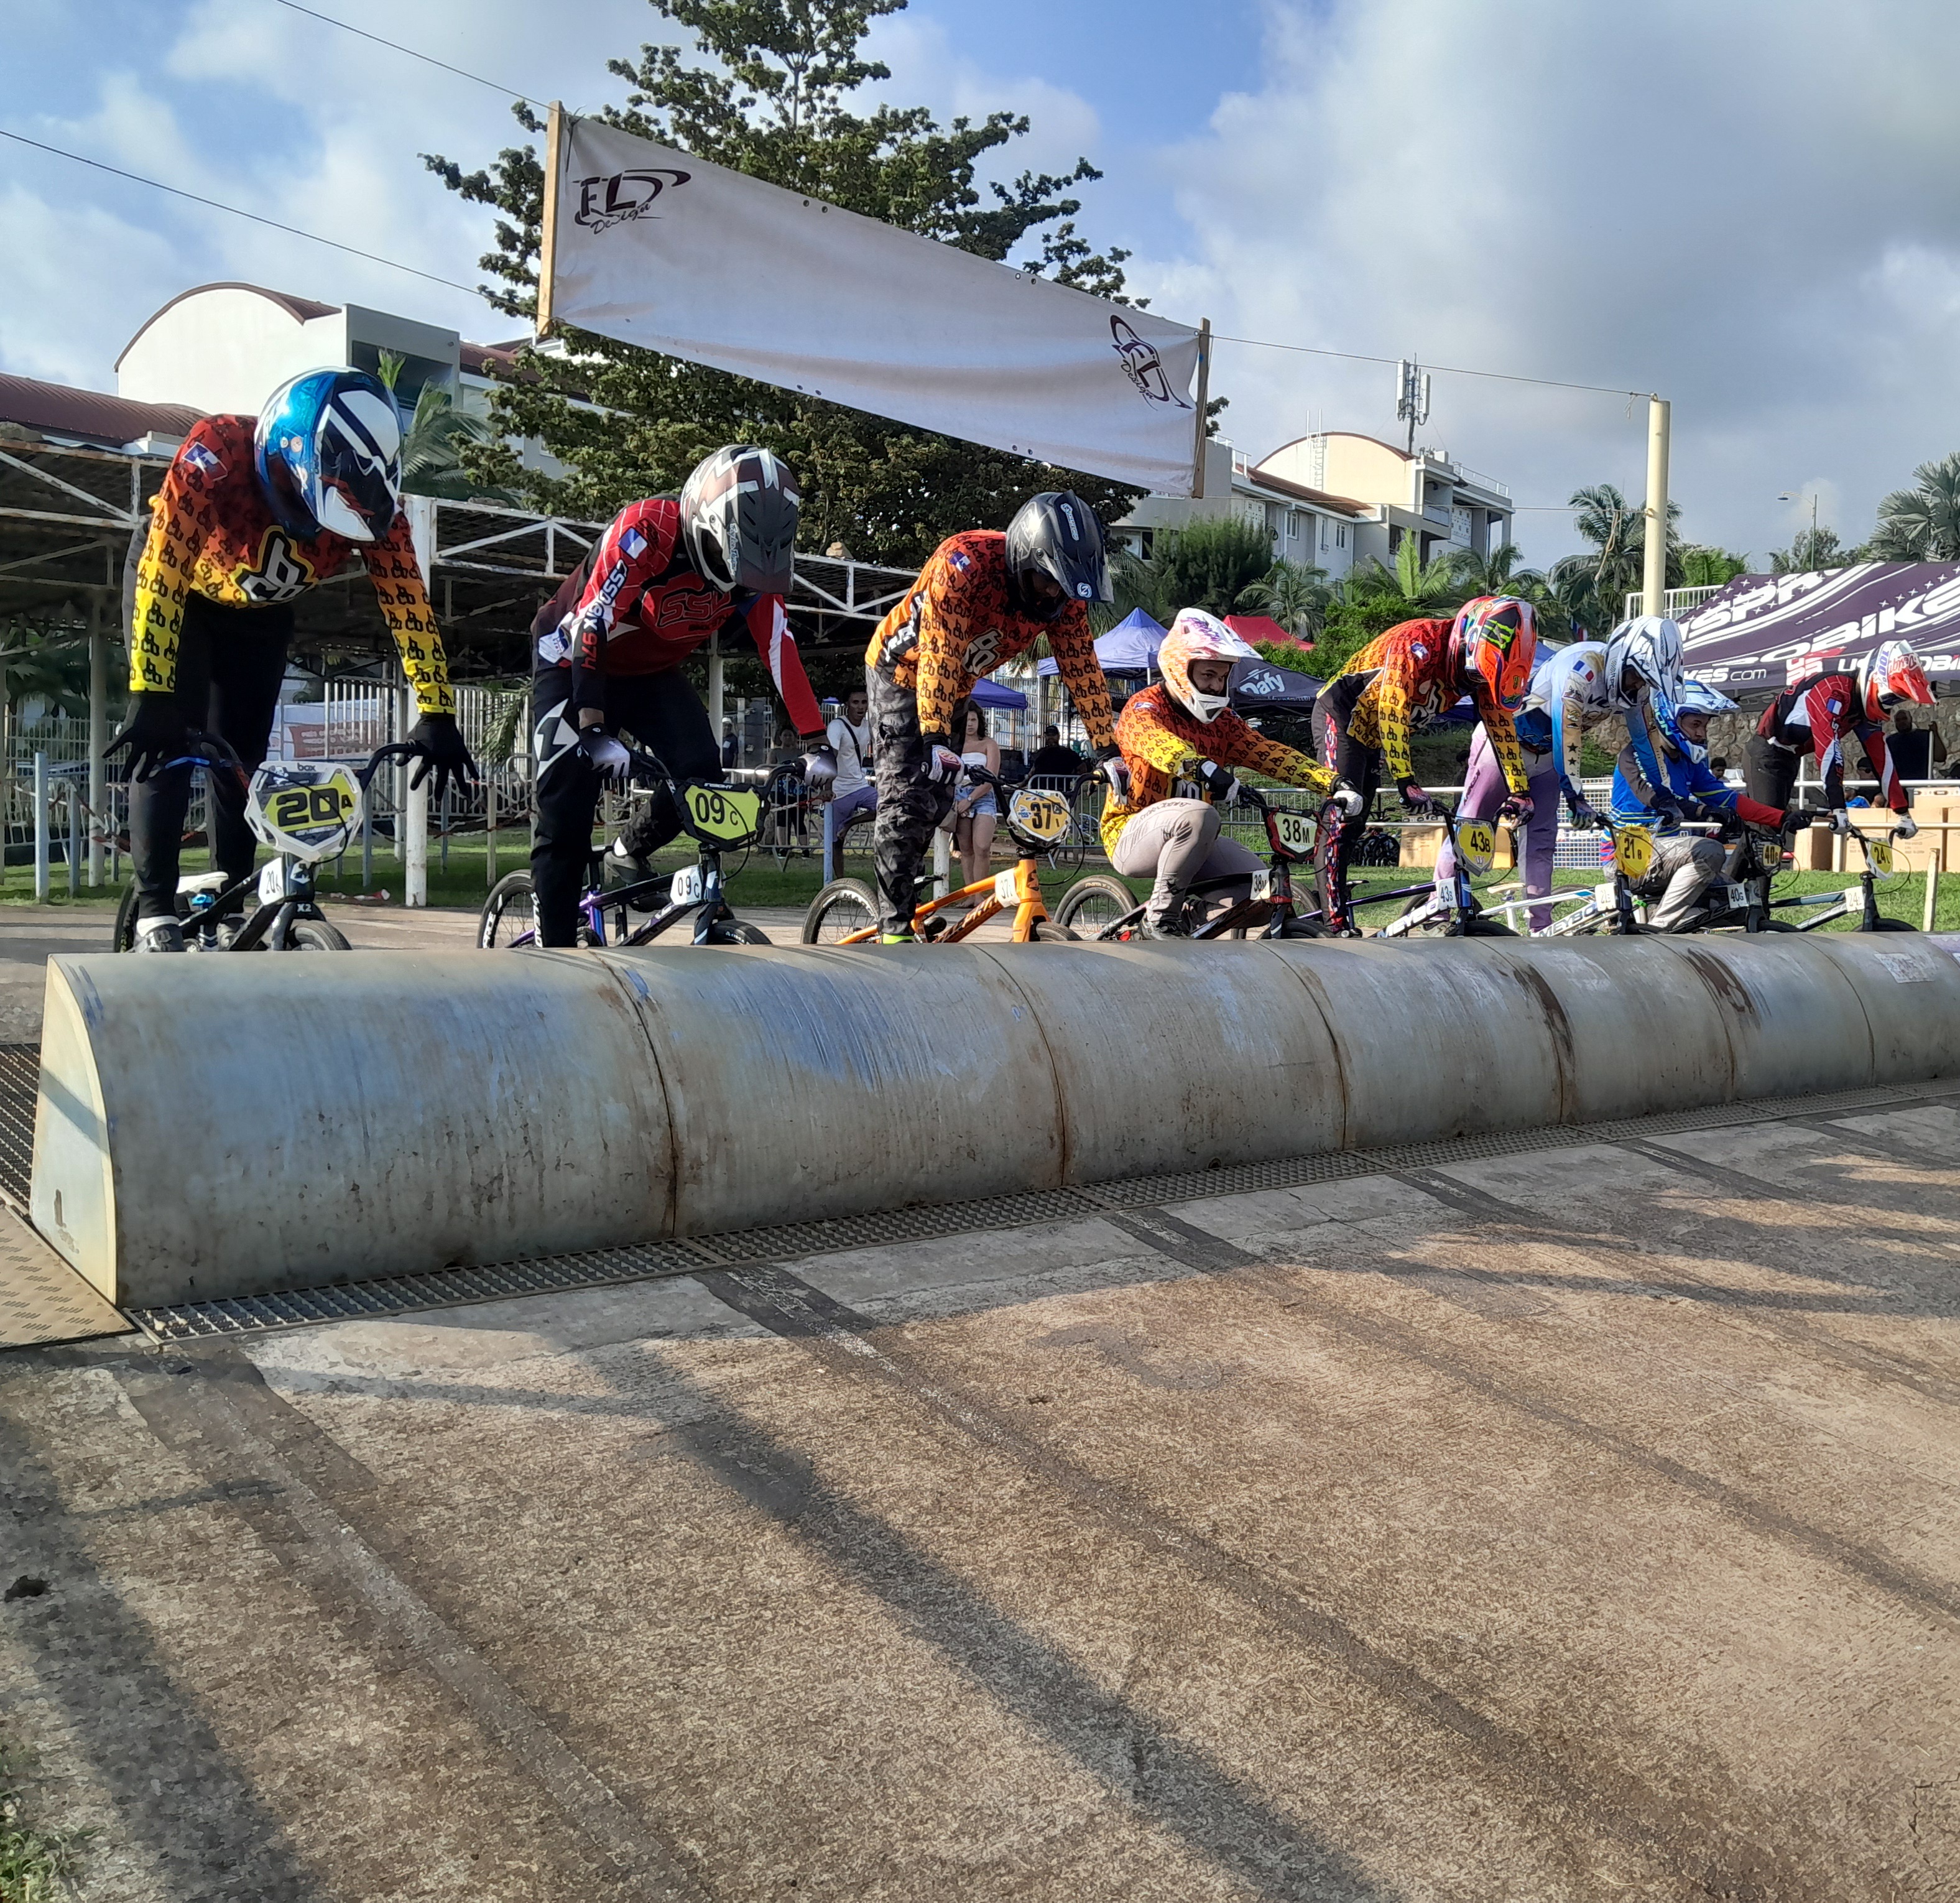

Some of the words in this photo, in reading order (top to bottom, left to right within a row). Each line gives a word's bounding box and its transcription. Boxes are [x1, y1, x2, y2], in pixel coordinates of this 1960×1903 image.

[581, 632, 598, 670] 974
[297, 762, 316, 772] box
[297, 904, 312, 912] X2
